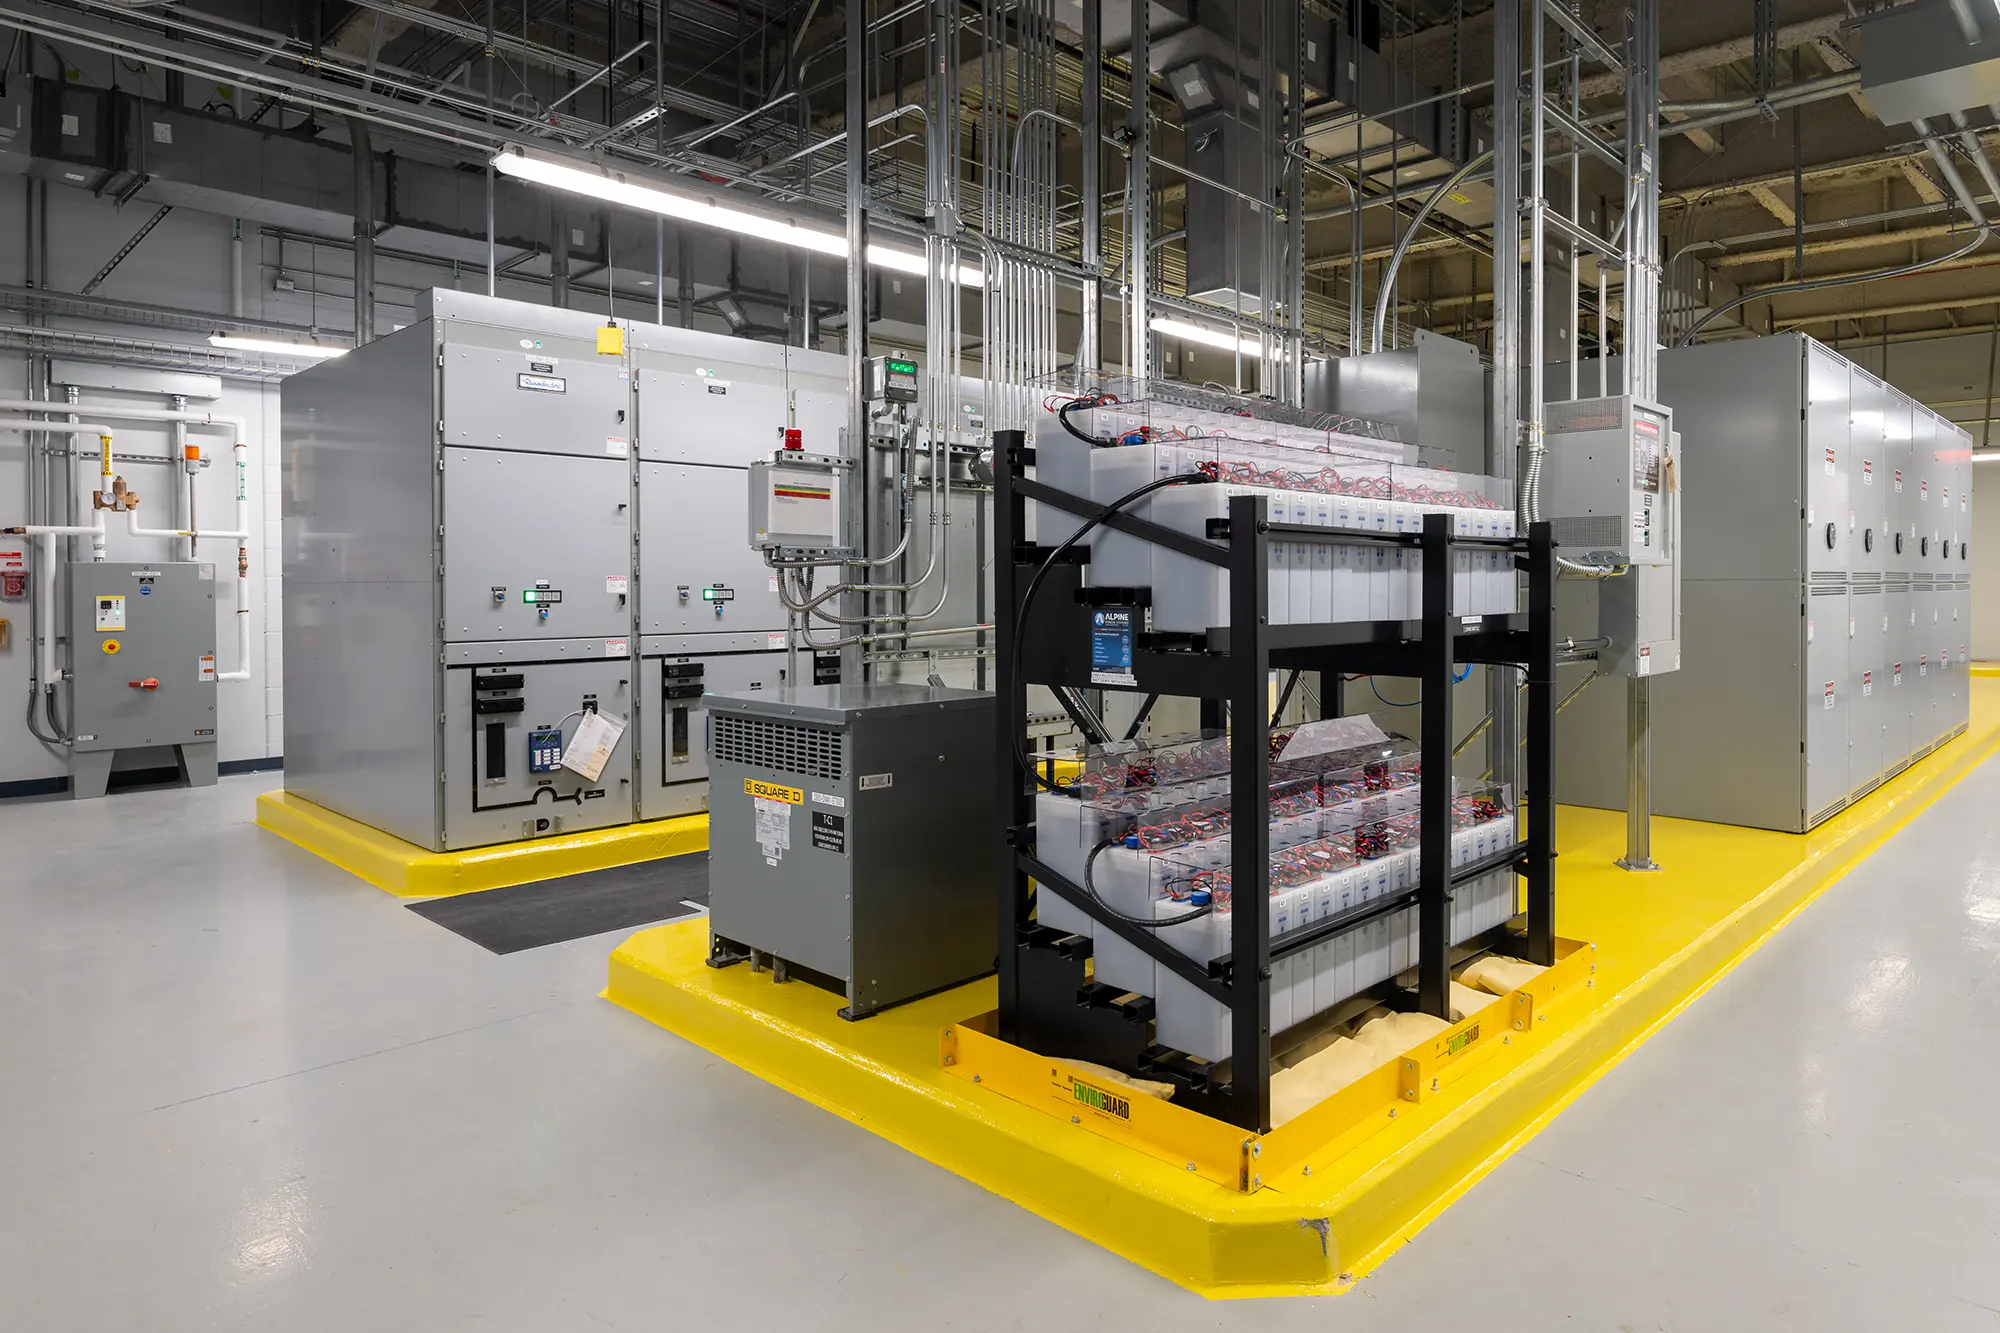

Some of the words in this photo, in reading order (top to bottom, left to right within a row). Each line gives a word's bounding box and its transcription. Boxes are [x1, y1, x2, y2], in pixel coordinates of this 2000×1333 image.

[523, 378, 561, 389] Russelectric
[1105, 613, 1128, 621] ALPINE
[754, 783, 789, 800] SQUARE
[792, 791, 801, 802] D
[1074, 1082, 1130, 1120] ENVIROGUARD
